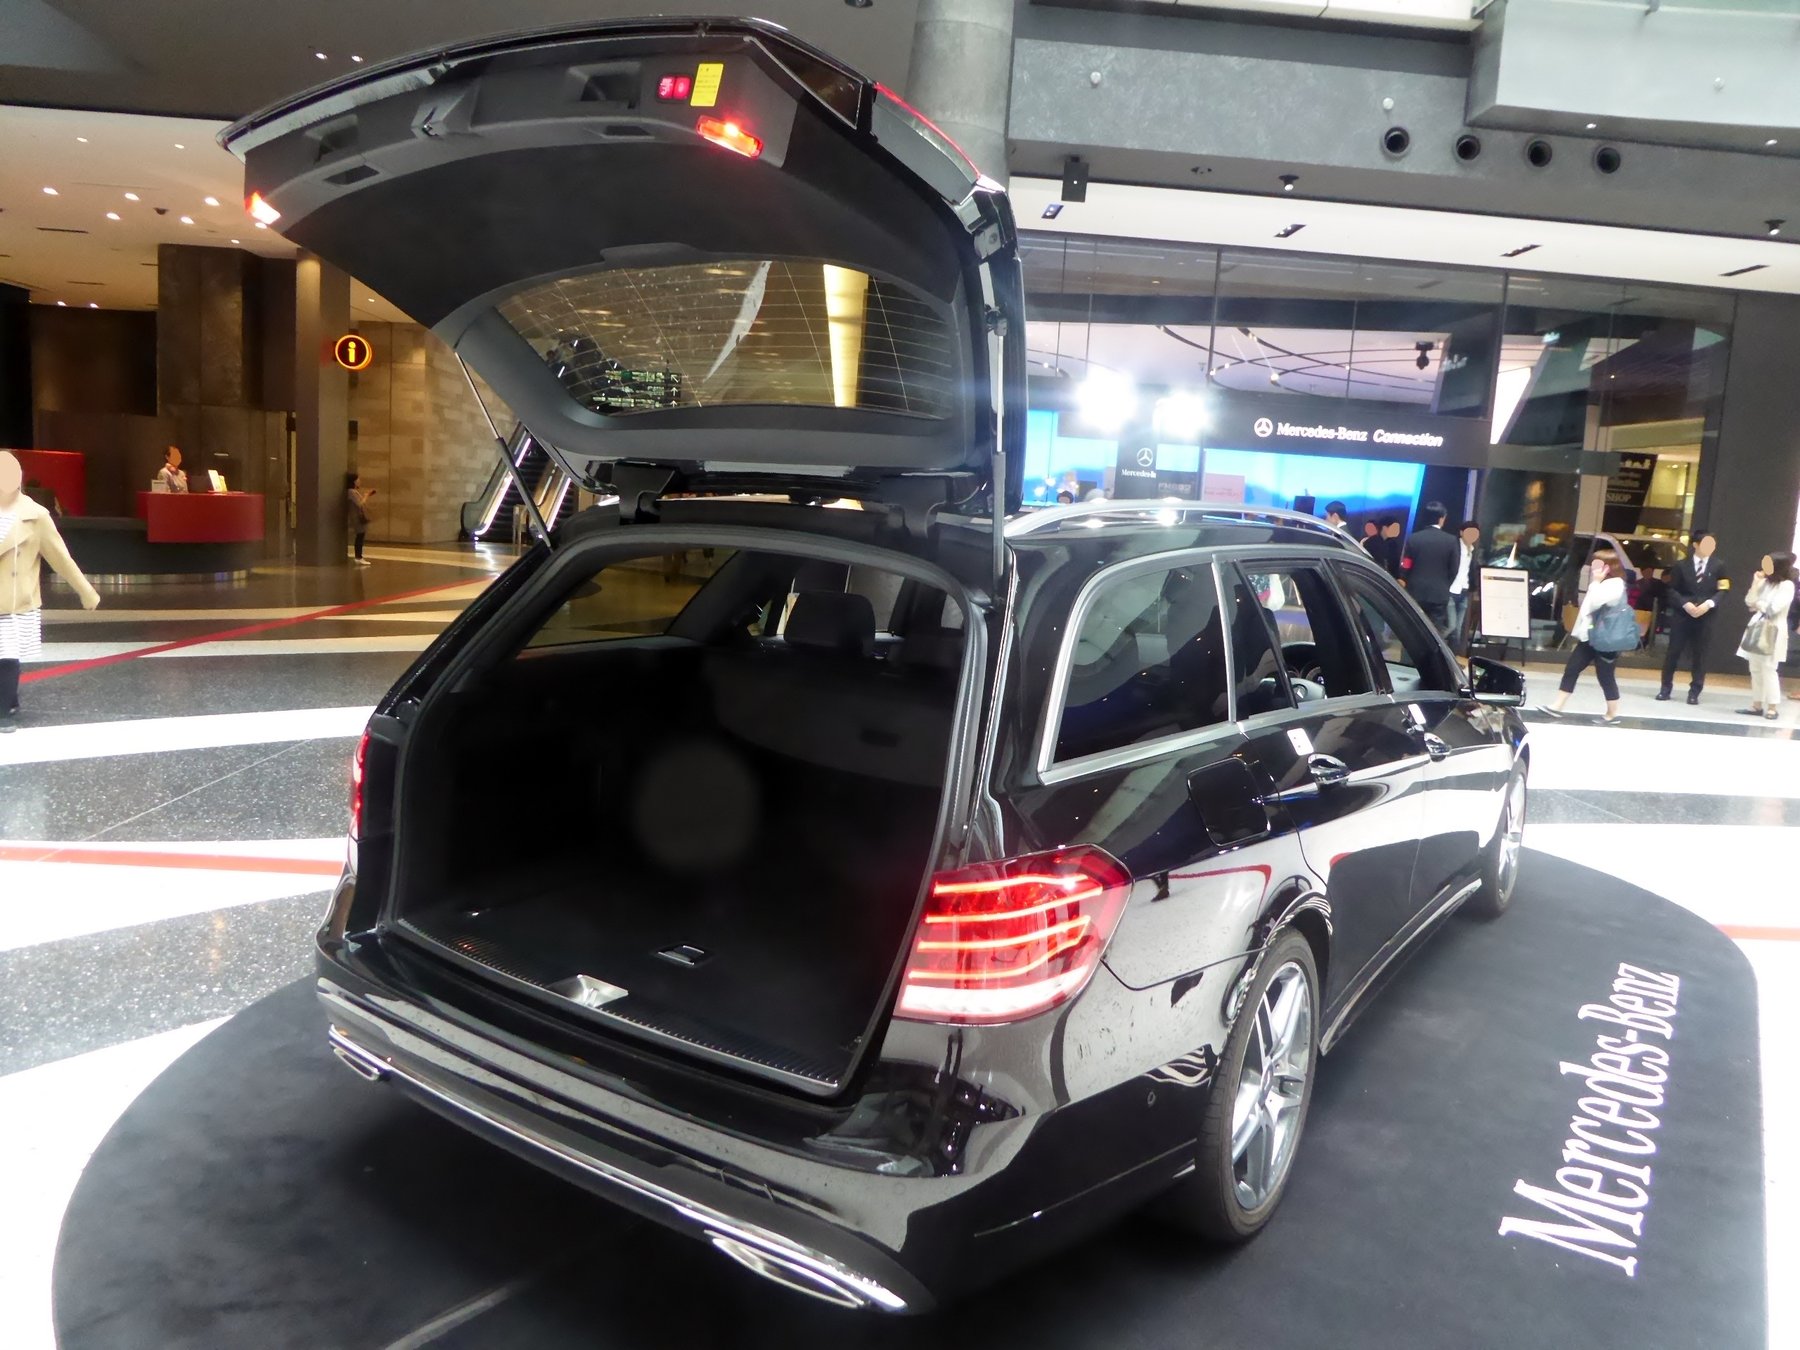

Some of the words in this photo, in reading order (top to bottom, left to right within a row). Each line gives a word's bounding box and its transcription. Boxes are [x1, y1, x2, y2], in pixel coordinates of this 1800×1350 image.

[1277, 423, 1368, 441] Mercedes-Benz
[1373, 429, 1444, 447] Connection
[1498, 962, 1680, 1277] Mercedes-Benz
